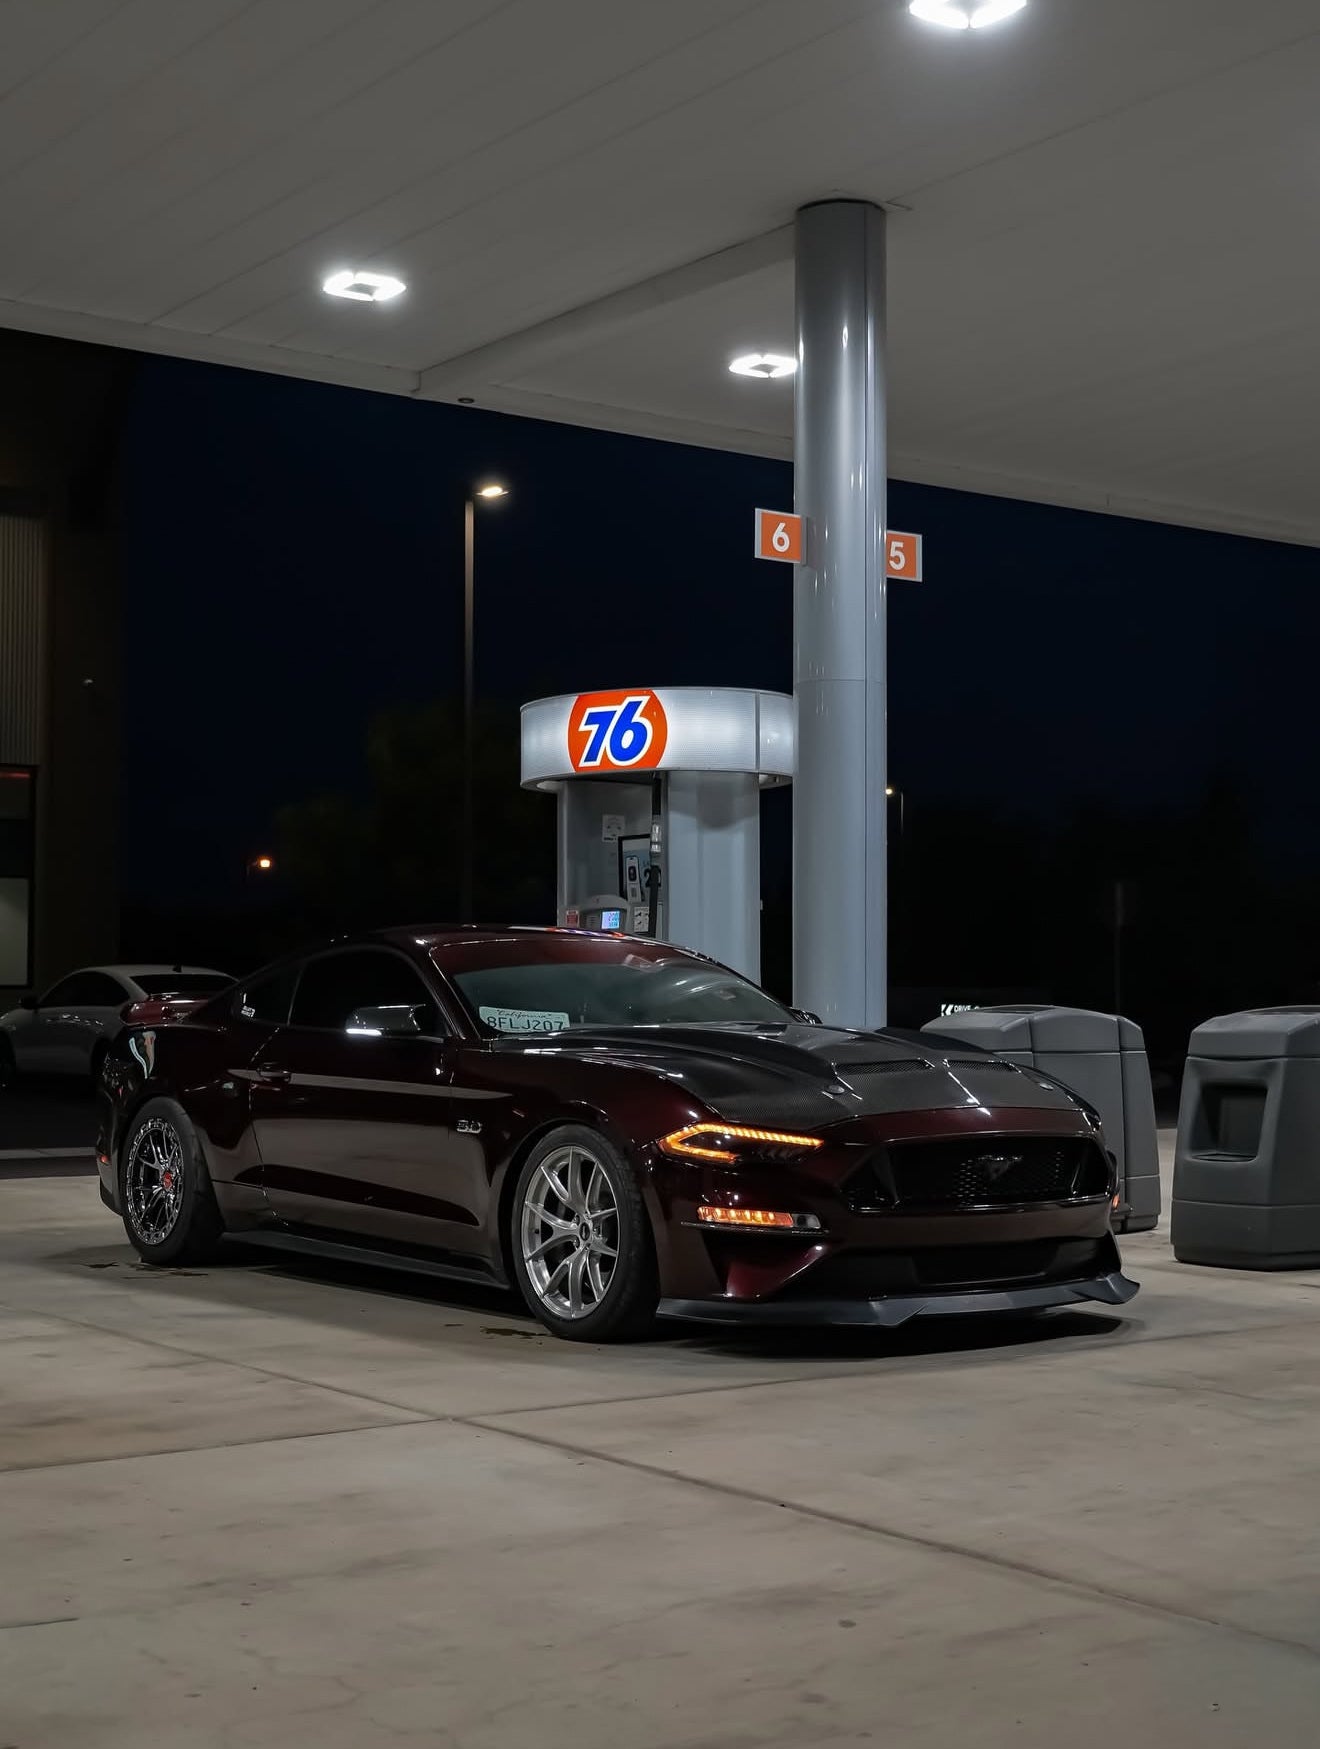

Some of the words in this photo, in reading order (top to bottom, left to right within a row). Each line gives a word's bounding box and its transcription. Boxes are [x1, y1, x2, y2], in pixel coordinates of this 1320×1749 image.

[772, 522, 790, 553] 6
[888, 541, 906, 570] 5
[578, 695, 653, 767] 76
[487, 1016, 564, 1031] 8FLJ207
